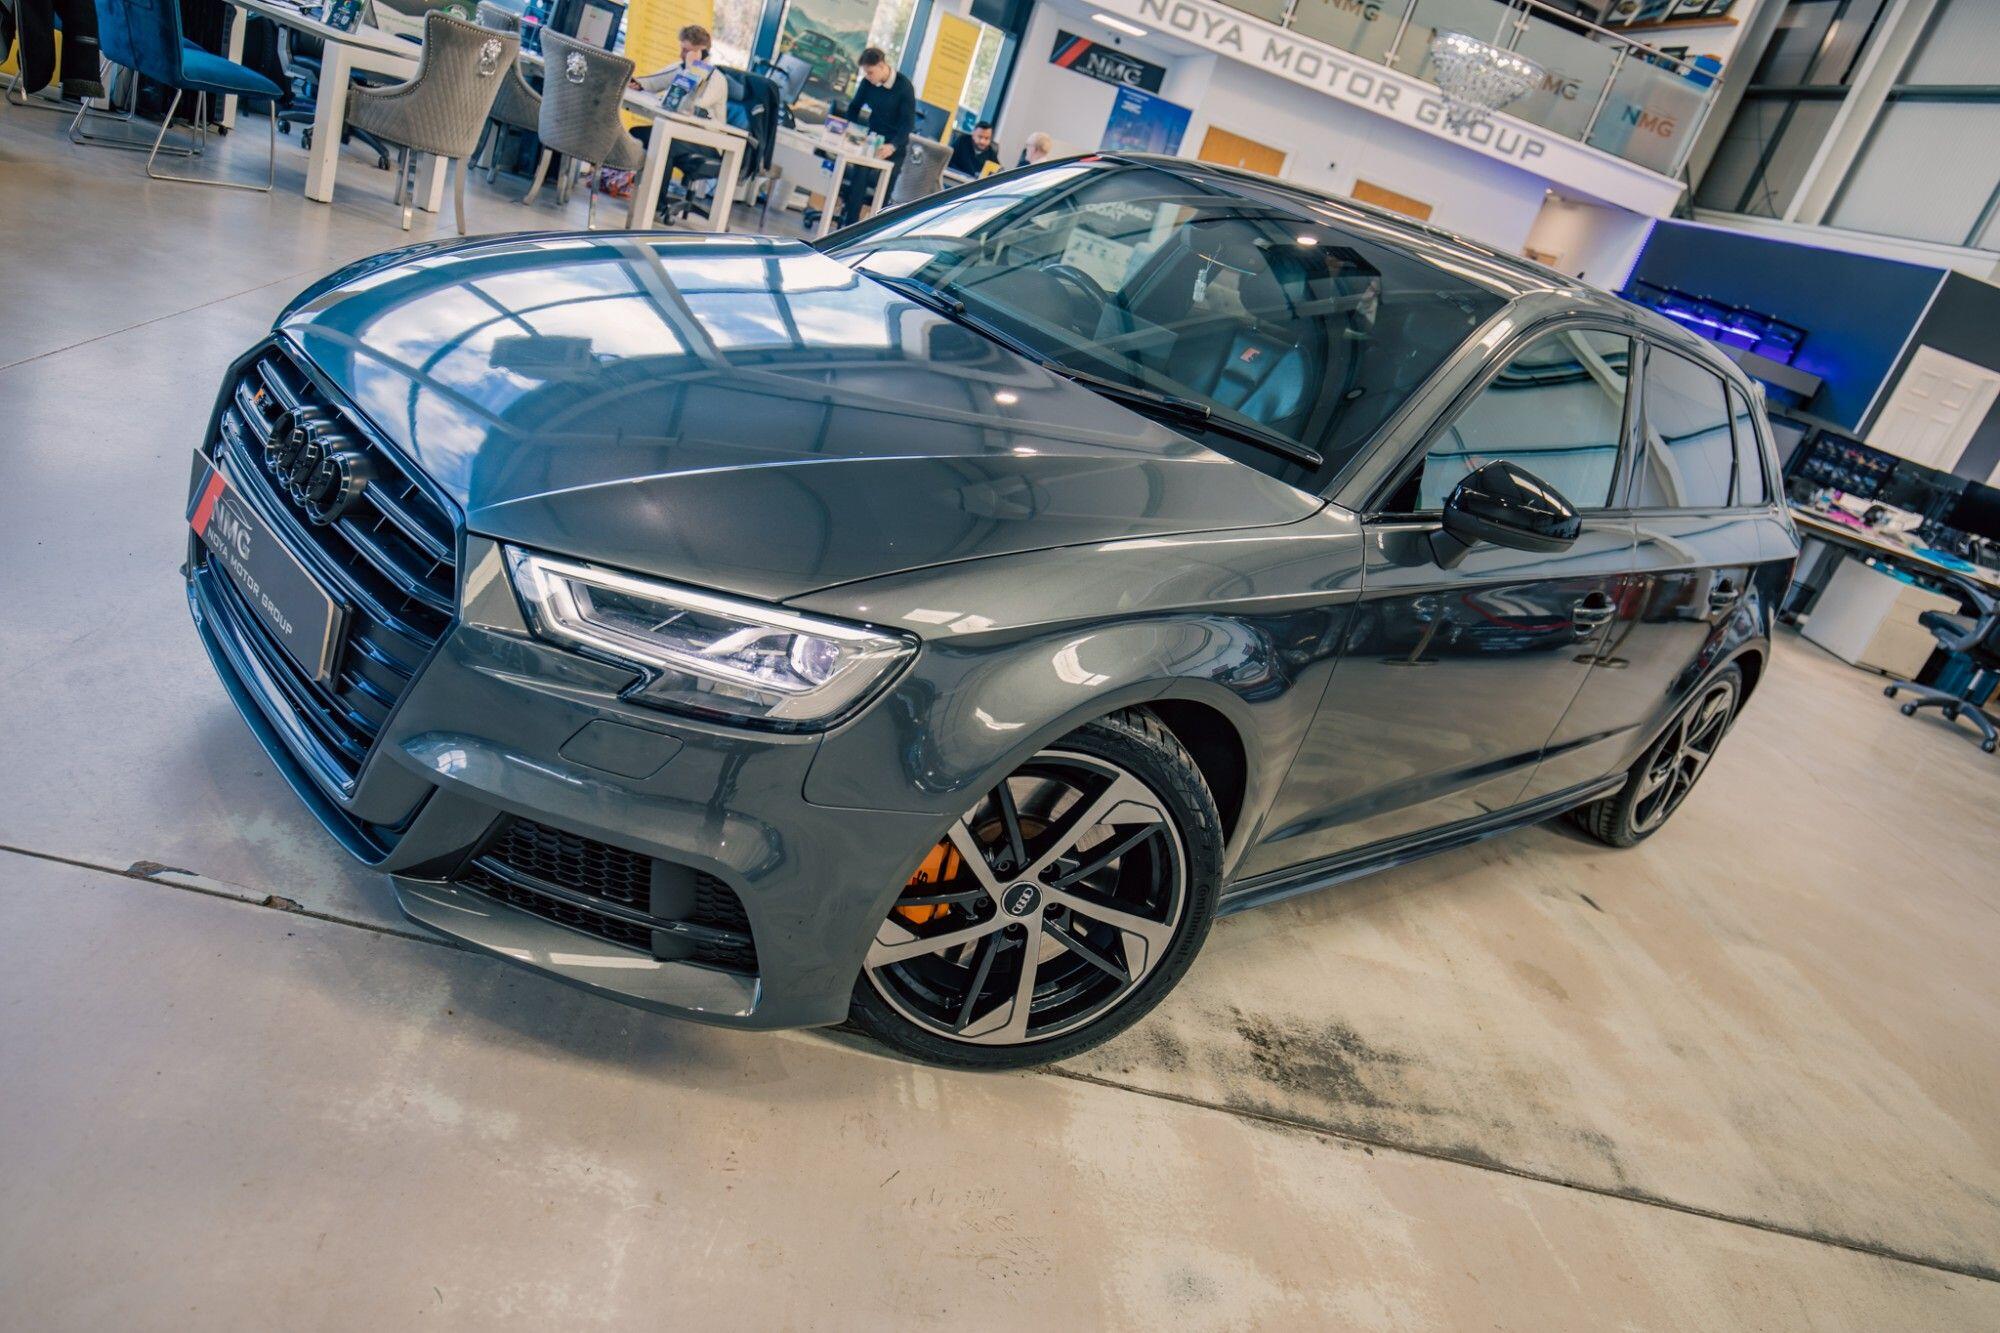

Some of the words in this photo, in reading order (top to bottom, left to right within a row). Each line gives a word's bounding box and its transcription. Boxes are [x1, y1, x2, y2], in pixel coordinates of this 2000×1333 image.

[1087, 52, 1143, 85] NMG
[1138, 0, 1243, 52] NOYA
[1262, 37, 1401, 111] MOTOR
[1621, 104, 1676, 138] NMG
[211, 494, 252, 560] NMG
[207, 526, 228, 559] NOYA
[230, 556, 260, 598] MOTOR
[261, 592, 293, 634] GROUP
